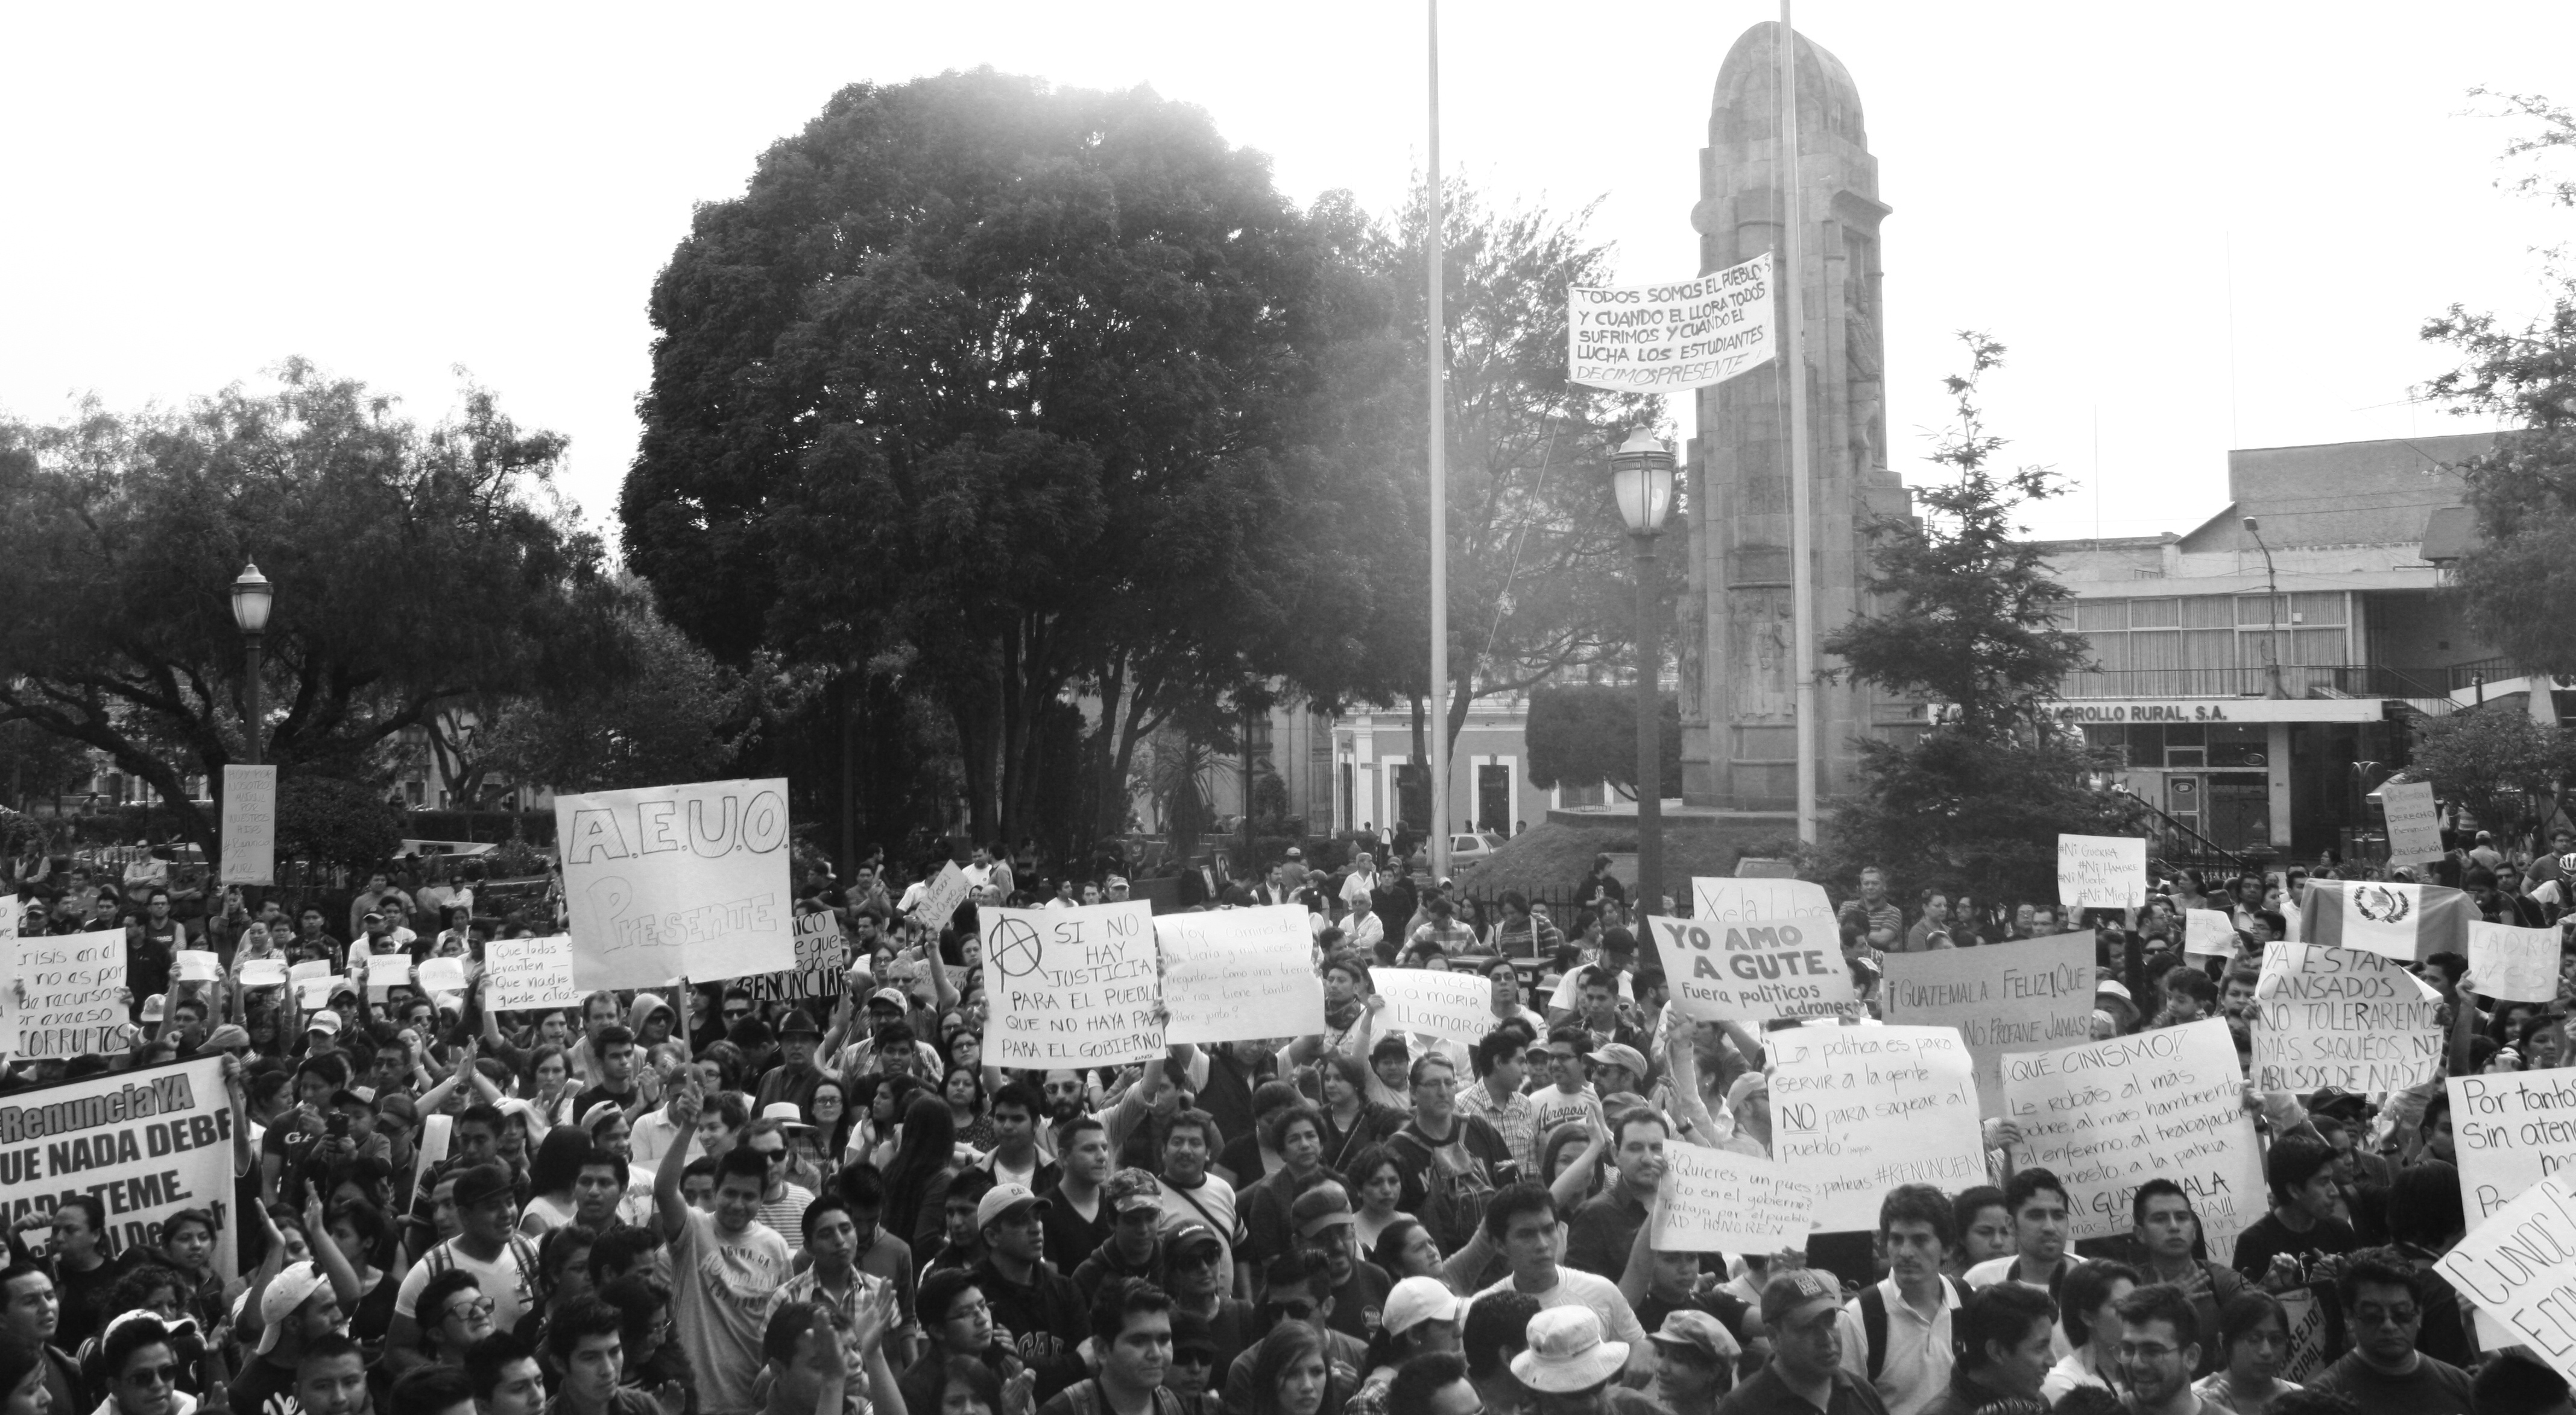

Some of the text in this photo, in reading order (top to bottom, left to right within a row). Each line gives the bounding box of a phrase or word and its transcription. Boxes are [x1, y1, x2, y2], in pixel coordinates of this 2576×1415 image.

[1575, 264, 1762, 304] TODOS SOMOS EL PUEBLO
[1579, 282, 1766, 328] Y CUANDO EL LLORA TODOS
[1579, 308, 1744, 344] SUFRIMOS Y CUANDO EL
[1577, 324, 1764, 364] LUCHA LOS ESTUDIANTES
[2131, 705, 2189, 723] RURAL,
[2195, 705, 2227, 721] S.A.
[2388, 811, 2435, 822] DERECHO
[1055, 913, 1139, 944] SI NO
[1170, 917, 1297, 948] Voy de
[1662, 922, 1803, 951] YO AMO
[810, 935, 838, 958] que
[1086, 940, 1126, 965] HAY
[1166, 941, 1293, 965] mi tierra y mil veces
[2264, 942, 2290, 970] YA
[36, 964, 126, 987] no por
[1047, 959, 1152, 987] JUSTICIA
[1252, 967, 1272, 977] una
[1280, 961, 1310, 976] tierra
[1693, 950, 1839, 981] A GUTE.
[495, 973, 569, 990] Que nadie
[1166, 993, 1185, 1002] tan
[1263, 981, 1292, 996] tanto
[1681, 982, 1732, 1004] Fuera
[2258, 973, 2395, 1000] CANSADOS
[498, 992, 535, 1008] quede
[1012, 983, 1158, 1011] PARA EL PUEBLO
[1005, 1009, 1161, 1033] QUE NO HAYA PAZ
[2258, 1001, 2291, 1031] NO
[1002, 1032, 1162, 1058] PARA EL GOBIERNO
[1963, 1019, 1986, 1046] NO
[1990, 1017, 2042, 1045] PROFANE
[1886, 1039, 1910, 1053] es
[2062, 1029, 2189, 1074] CINISMO!
[2257, 1033, 2442, 1062] MÁS NI
[1842, 1060, 1930, 1095] a la gente
[2261, 1065, 2328, 1091] ABUSOS
[2336, 1065, 2360, 1091] DE
[1782, 1103, 1817, 1131] NO
[1946, 1081, 1968, 1106] al
[2010, 1097, 2038, 1116] Le
[2120, 1072, 2142, 1099] al
[2150, 1069, 2196, 1091] más
[2463, 1078, 2507, 1116] Por
[0, 1072, 195, 1144] RenunciaYA
[1537, 1101, 1589, 1135] Aeropost
[2076, 1113, 2095, 1130] al
[2099, 1107, 2141, 1126] más
[0, 1107, 232, 1185] UE NADA DEBE
[2019, 1124, 2150, 1167] al al
[2463, 1121, 2513, 1149] Sin
[1875, 1151, 1983, 1186] #RENUNCIEN
[2129, 1151, 2170, 1173] a la
[87, 1168, 194, 1215] TEME.
[1676, 1179, 1693, 1196] to
[1700, 1190, 1719, 1198] en
[1724, 1188, 1740, 1203] el
[1750, 1174, 1770, 1185] un
[1662, 1198, 1711, 1218] Trabaja
[1752, 1209, 1764, 1220] el
[1766, 1215, 1810, 1225] pueblo
[1667, 1214, 1690, 1229] AD
[2071, 1223, 2104, 1235] más
